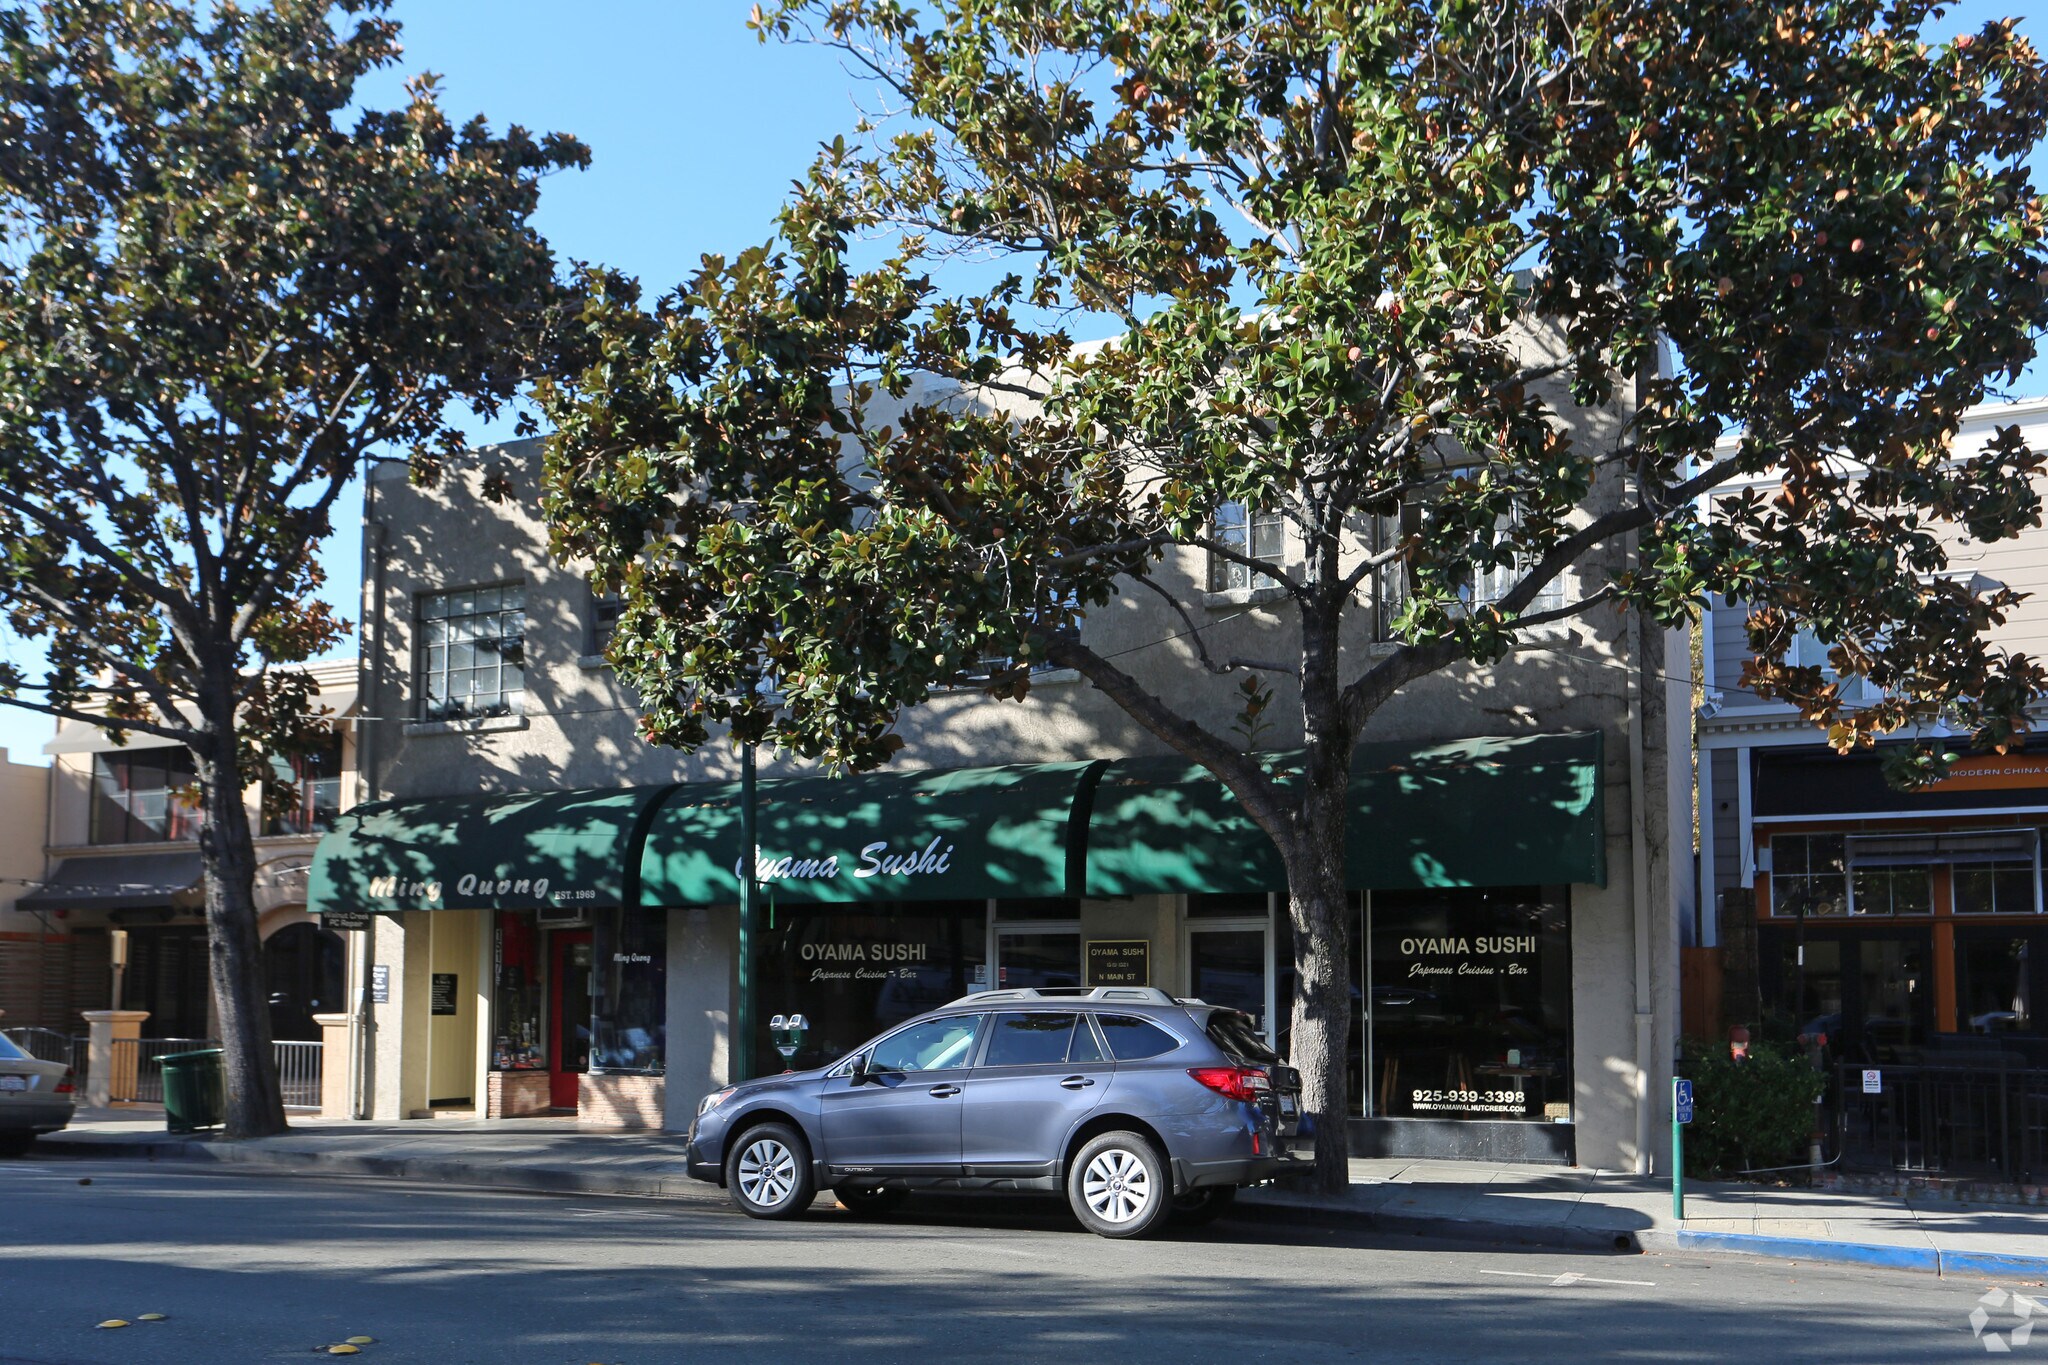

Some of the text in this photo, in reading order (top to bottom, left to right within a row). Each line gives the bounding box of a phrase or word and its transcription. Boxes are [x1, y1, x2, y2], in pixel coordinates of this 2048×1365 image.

[1949, 768, 2000, 777] MODERN
[2003, 767, 2041, 775] CHINA
[853, 835, 954, 878] Sushi
[369, 873, 549, 902] Ming Quong
[554, 890, 596, 900] EST. 1969
[801, 943, 926, 961] OYAMA SUSHI
[1091, 948, 1145, 956] OYAMA SUSHI
[1400, 936, 1536, 955] OYAMA SUSHI
[810, 967, 917, 982] Japanese Cuisine Bar
[1408, 962, 1528, 978] Japanese Cuisine Bar
[1412, 1089, 1526, 1103] 925-939-3398
[1412, 1102, 1527, 1113] WWW.OYAMAWALNUTCREEK.COM
